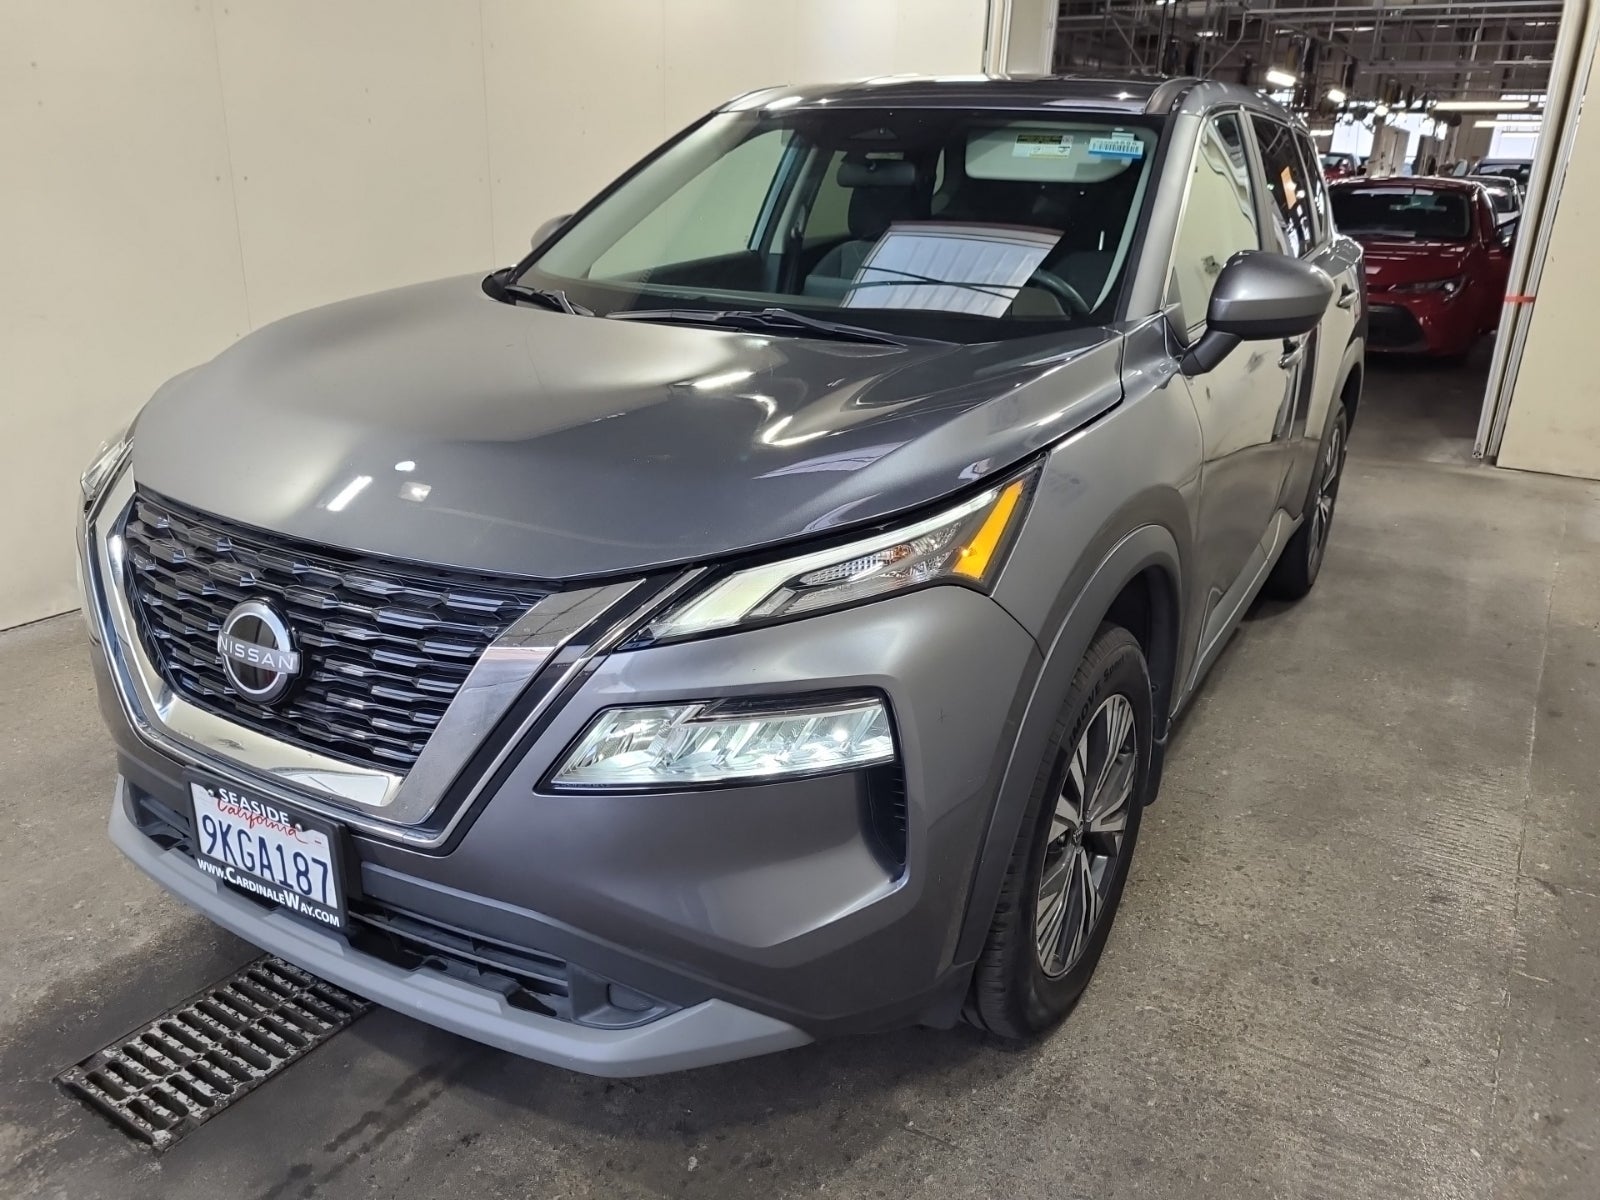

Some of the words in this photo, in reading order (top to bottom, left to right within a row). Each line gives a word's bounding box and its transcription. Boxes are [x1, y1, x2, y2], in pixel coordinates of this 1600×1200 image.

[218, 634, 294, 671] NISSAN
[217, 798, 308, 844] California
[218, 788, 290, 826] SEASIDE
[202, 814, 328, 903] 9KGA187
